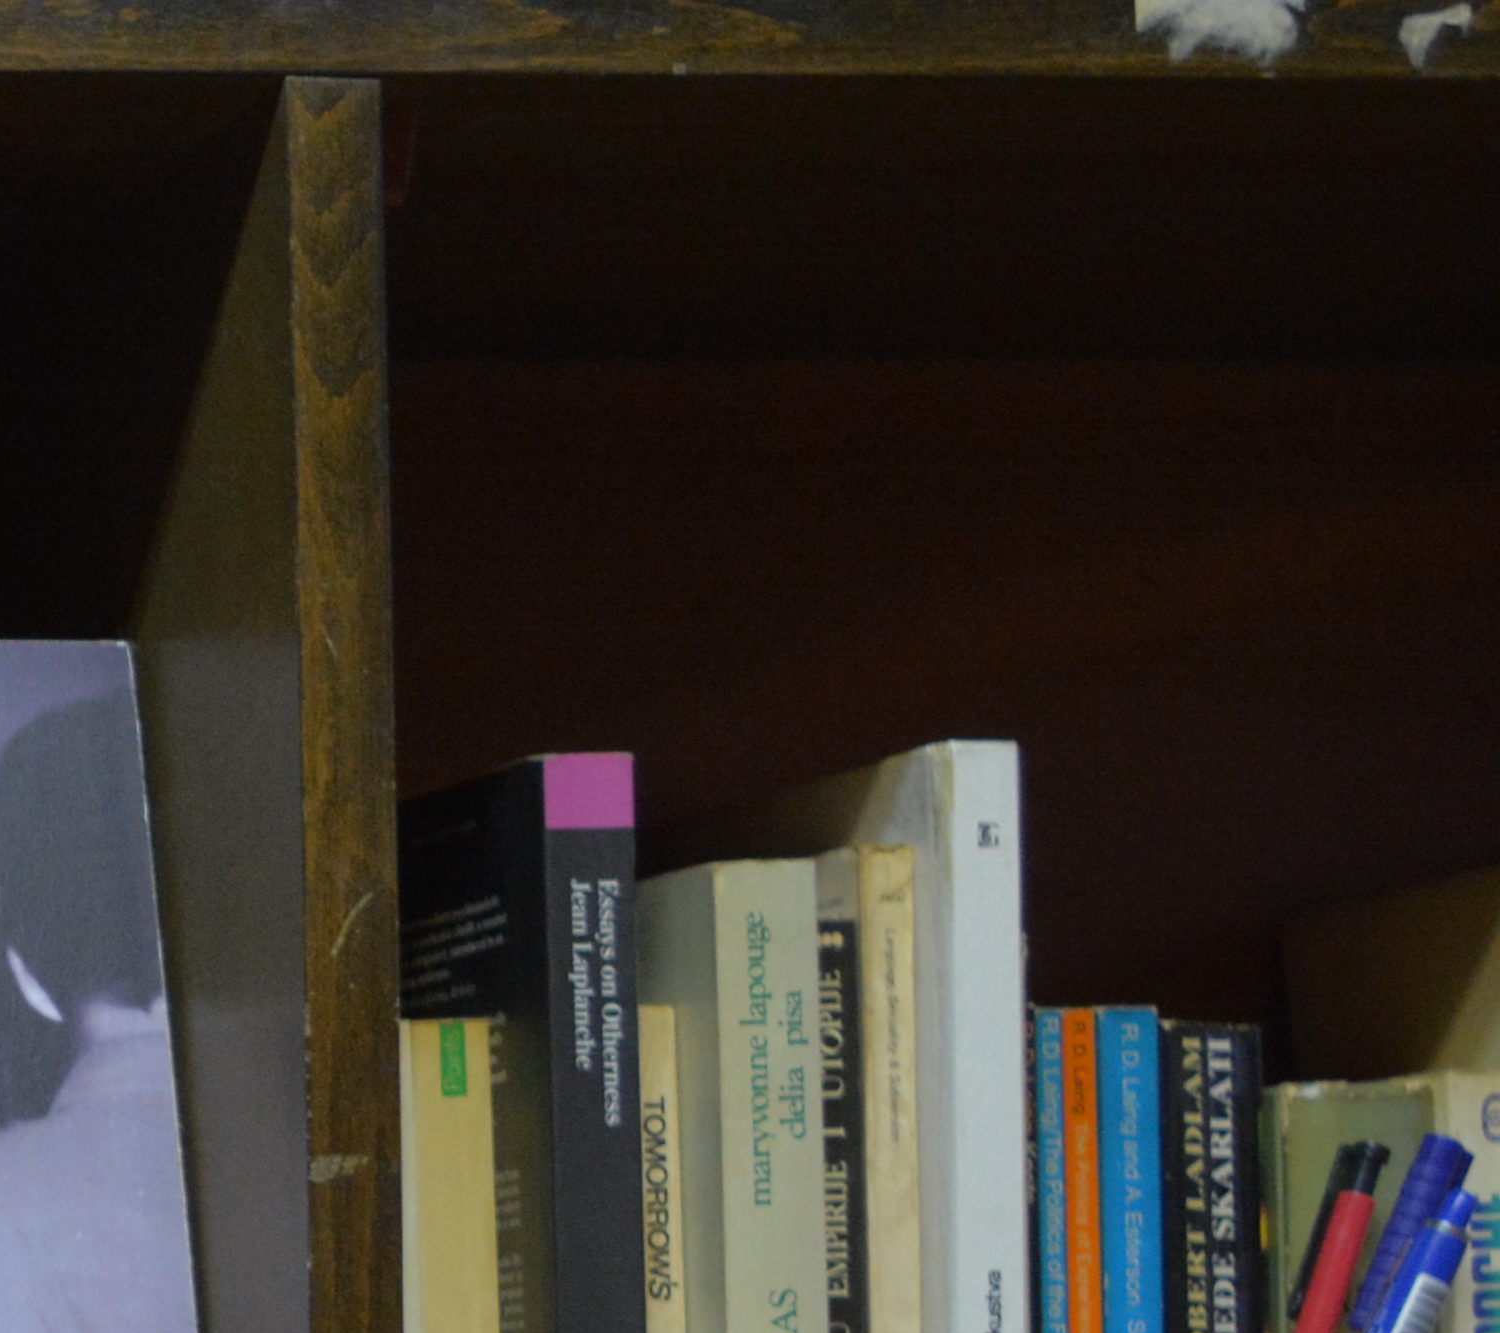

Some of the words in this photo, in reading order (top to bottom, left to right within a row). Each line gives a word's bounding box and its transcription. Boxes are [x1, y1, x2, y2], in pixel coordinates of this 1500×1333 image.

[570, 879, 593, 937] Jean
[594, 879, 622, 961] Essays
[737, 910, 773, 1027] lapouge
[567, 942, 596, 1072] Laplanche
[600, 964, 617, 997] on
[777, 989, 809, 1046] pisa
[600, 1001, 625, 1128] Otherness
[750, 1034, 776, 1207] maryvonne
[779, 1066, 807, 1140] delia
[1181, 1034, 1206, 1210] LADLAM
[1206, 1034, 1236, 1240] SKARLATI
[642, 1095, 679, 1303] TOMORROW'S
